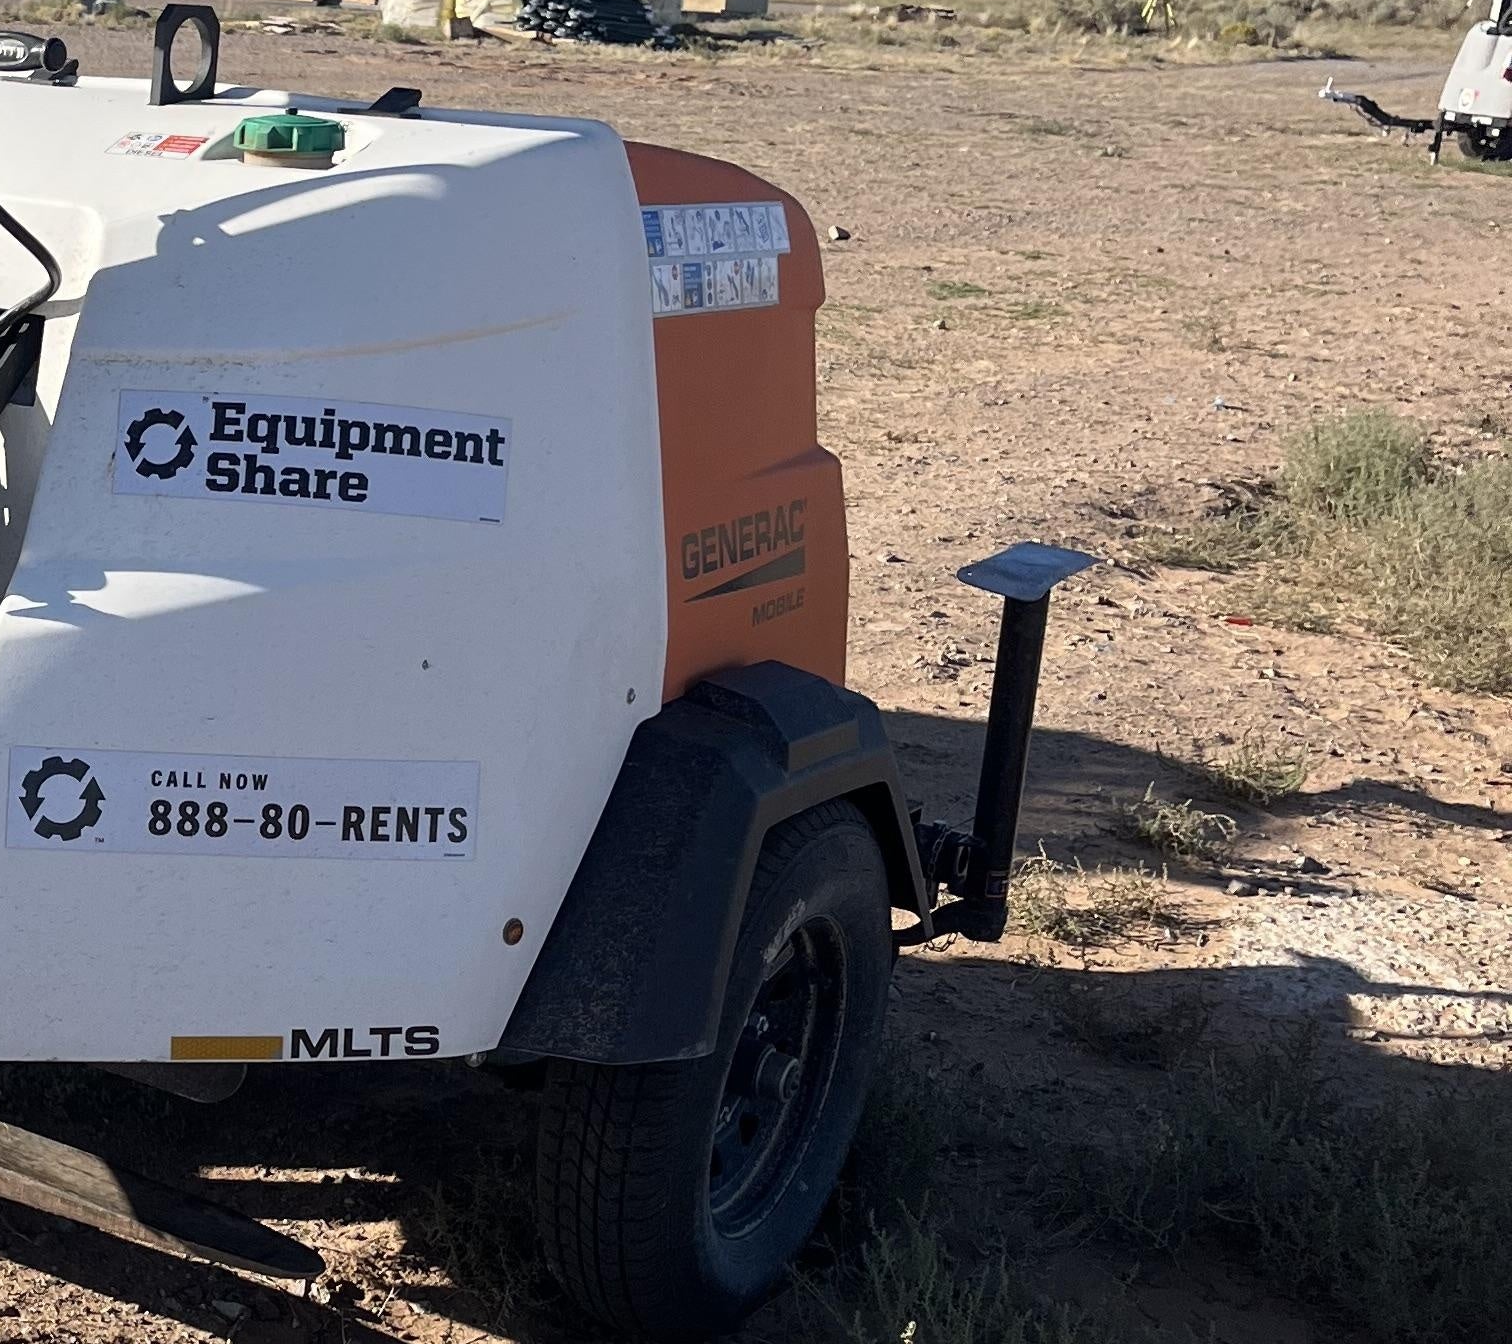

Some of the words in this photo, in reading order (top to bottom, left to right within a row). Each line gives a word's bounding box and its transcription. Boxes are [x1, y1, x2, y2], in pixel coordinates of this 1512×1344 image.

[209, 401, 506, 467] Equipment
[205, 452, 369, 503] Share
[681, 498, 805, 581] GENERAC
[751, 587, 806, 628] MOBILE
[150, 770, 207, 789] CALL
[219, 773, 269, 791] NOW
[147, 799, 469, 844] 888-80-RENTS
[290, 1025, 440, 1059] MLTS
